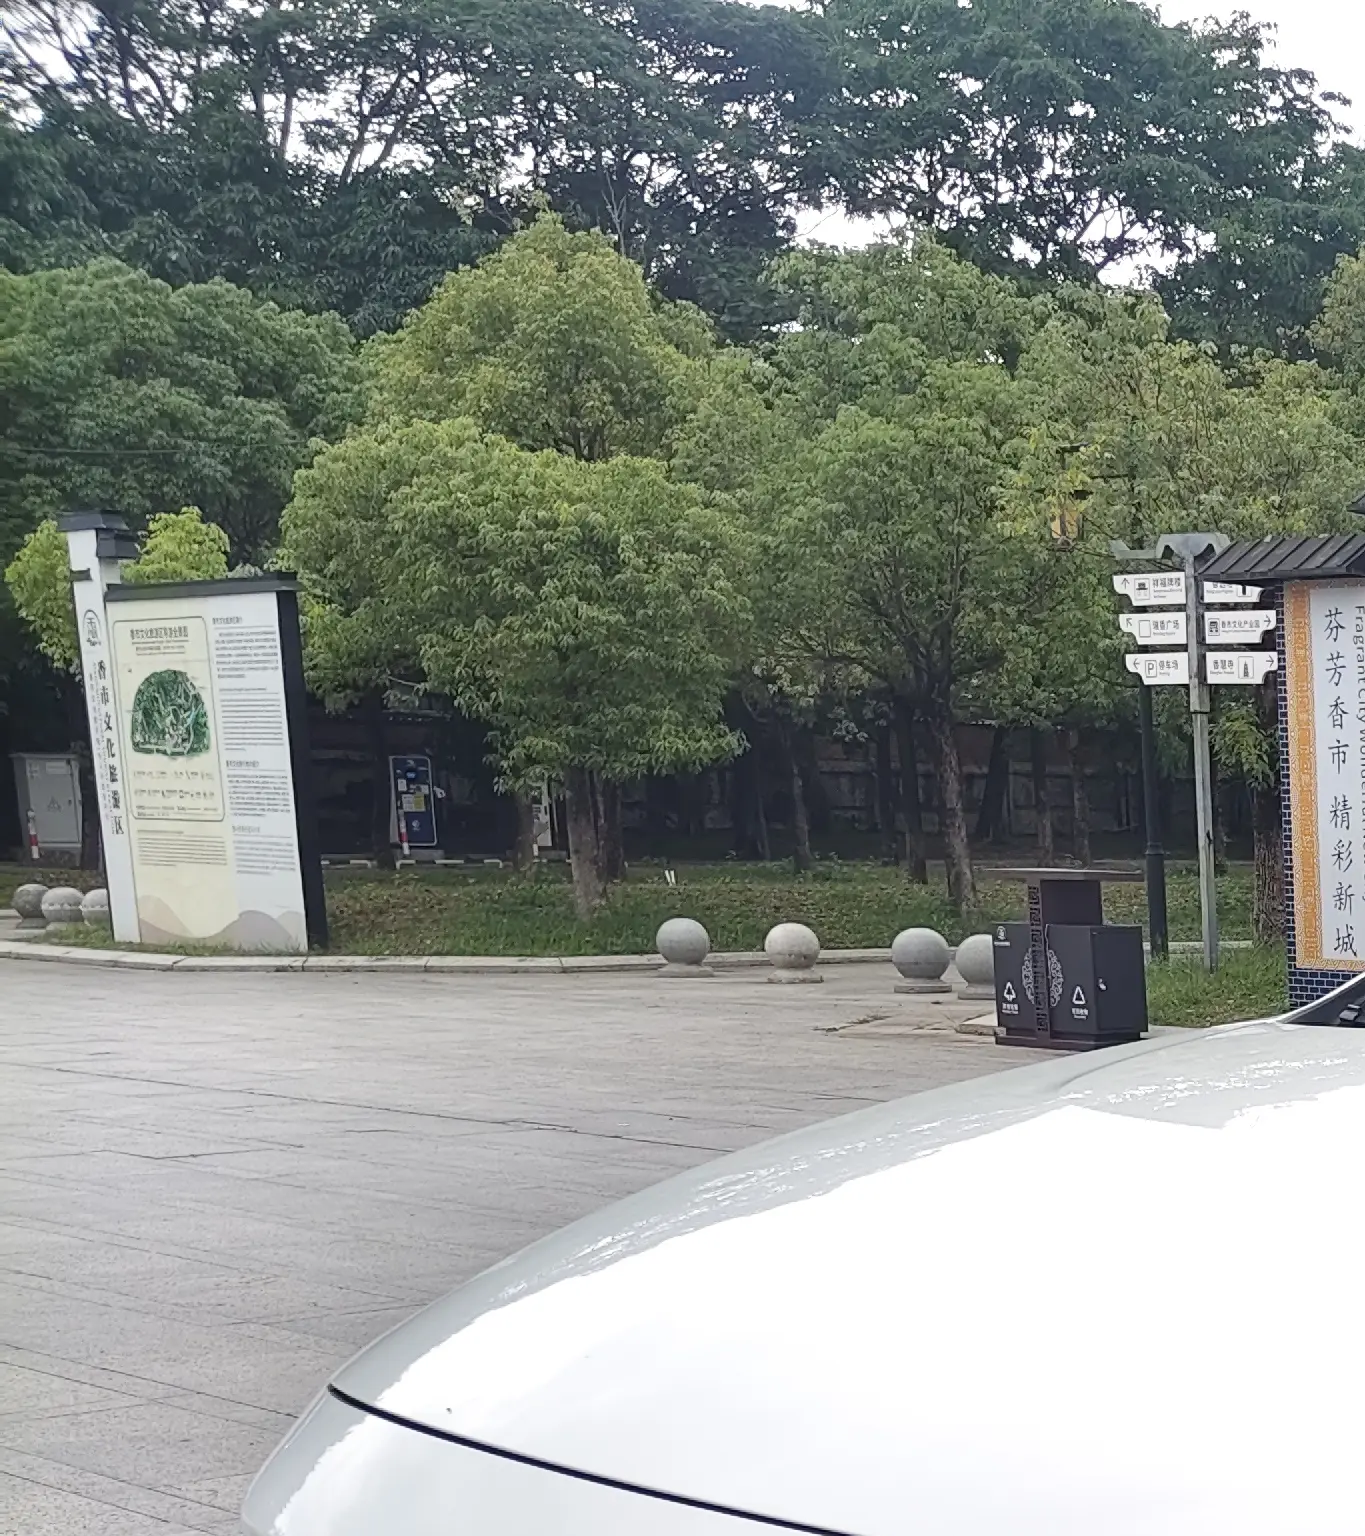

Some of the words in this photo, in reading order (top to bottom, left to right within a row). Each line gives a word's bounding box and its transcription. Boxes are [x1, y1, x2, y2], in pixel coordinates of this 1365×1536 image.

[1323, 607, 1349, 775] 芬芳香市
[1329, 795, 1358, 956] 精彩新城
